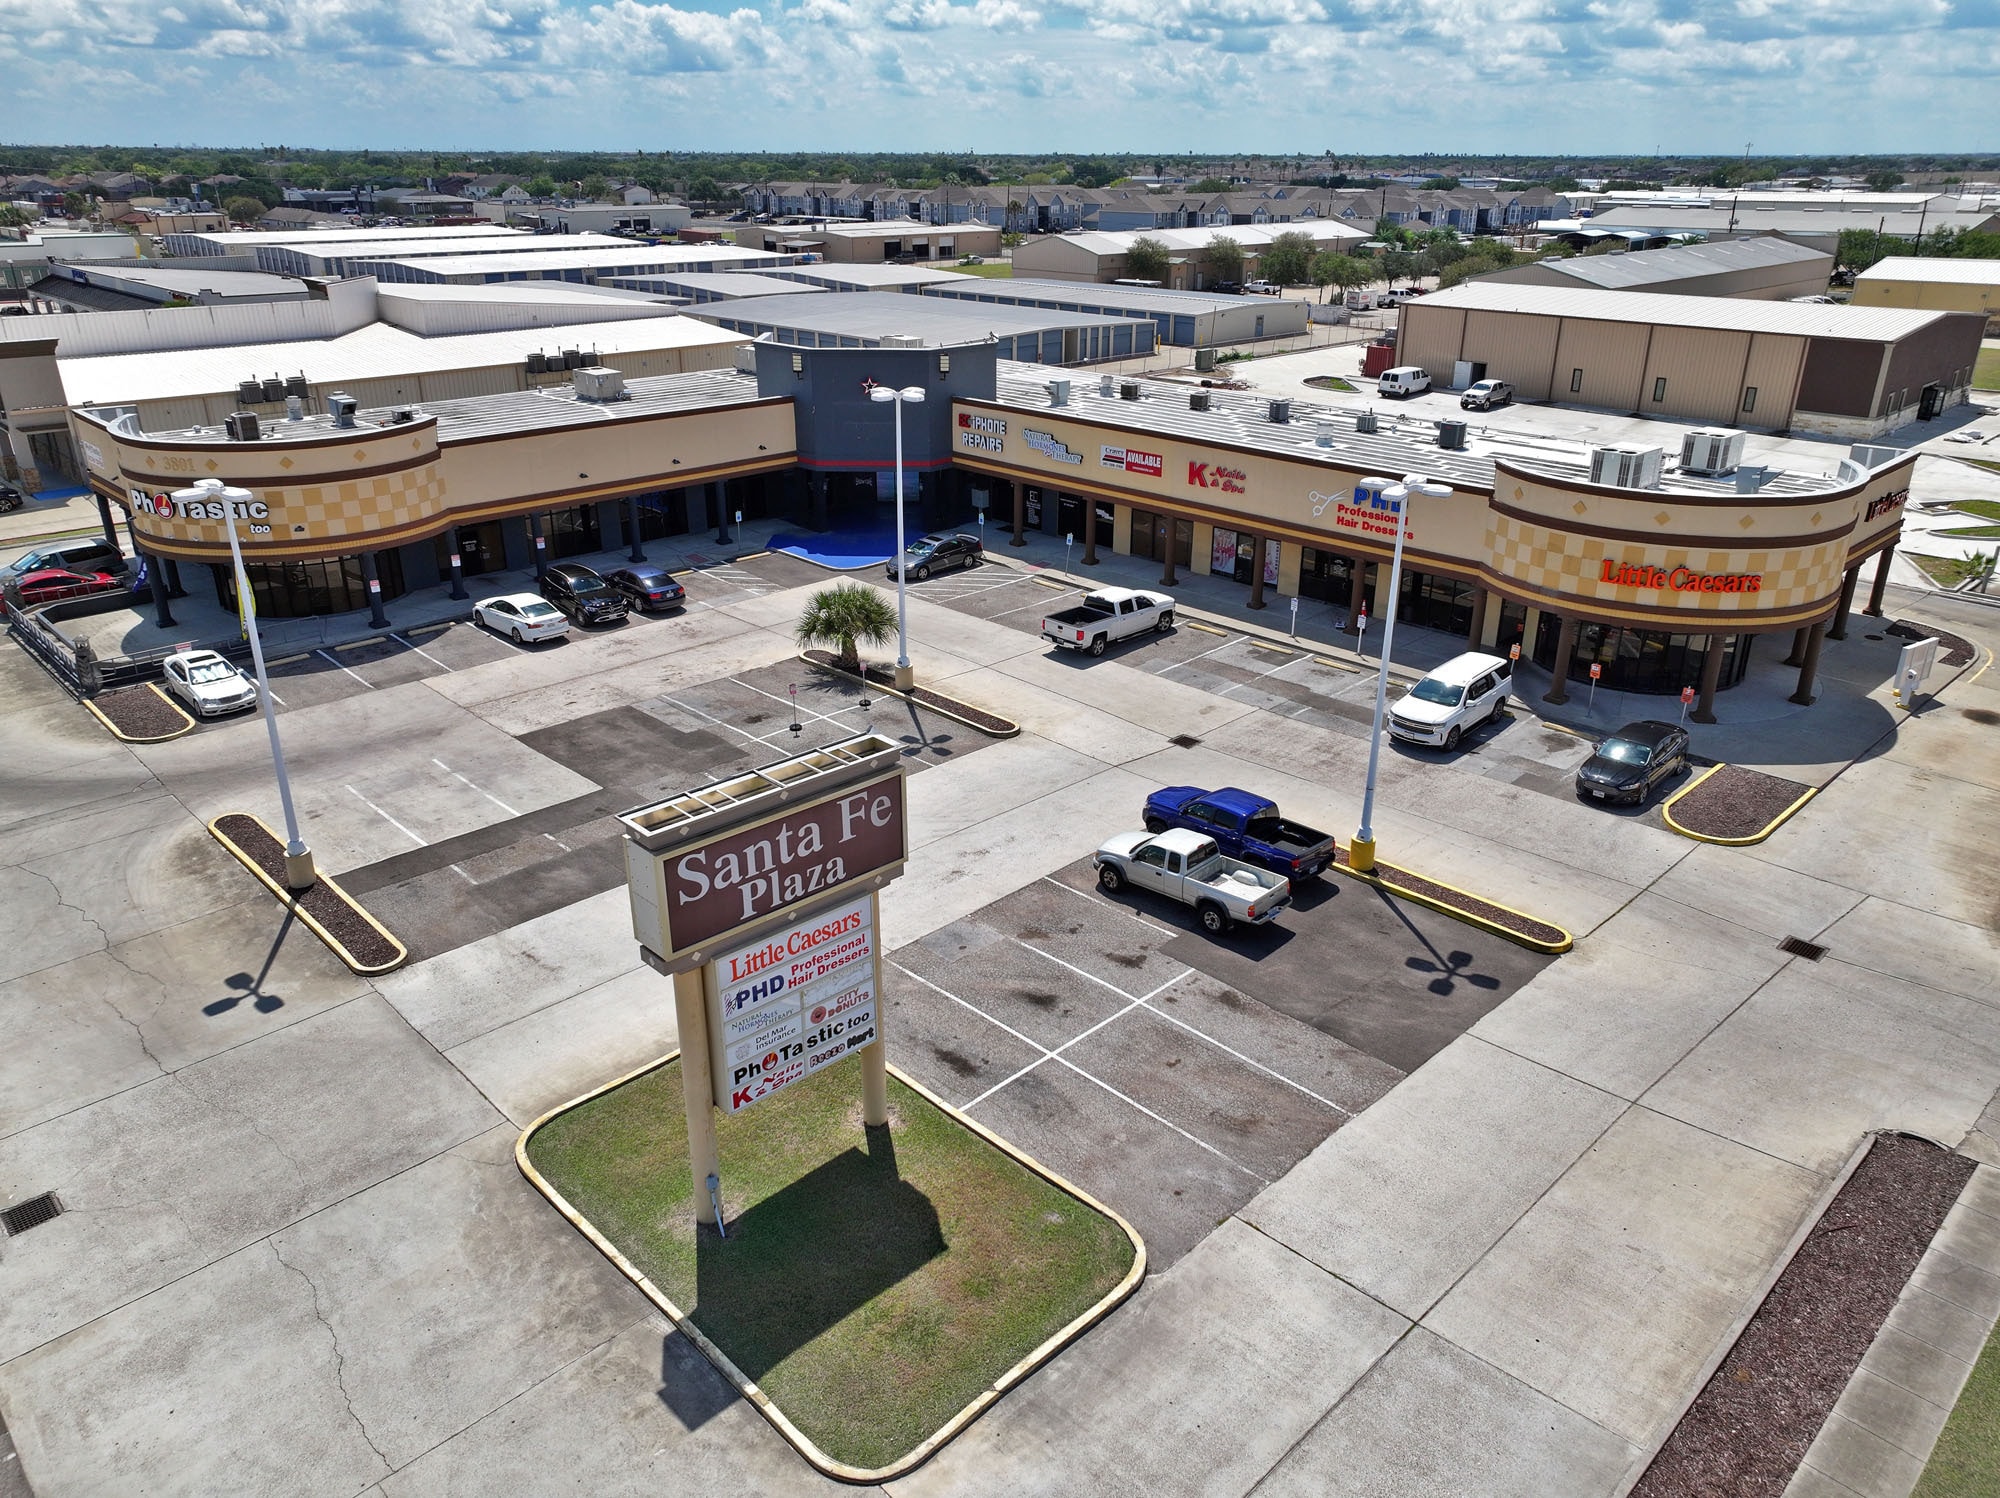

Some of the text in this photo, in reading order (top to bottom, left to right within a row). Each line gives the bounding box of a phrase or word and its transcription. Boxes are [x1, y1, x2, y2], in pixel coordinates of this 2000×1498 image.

[962, 431, 1003, 453] REPAIRS
[1028, 439, 1067, 453] HORMONES
[1051, 450, 1081, 464] THERAPY
[1127, 451, 1161, 468] AVAILABLE
[1188, 461, 1247, 488] K Nails
[1210, 479, 1246, 494] & Spa
[1336, 515, 1359, 529] Hair
[1337, 503, 1409, 526] Professionl
[249, 524, 271, 534] too
[1600, 558, 1762, 593] Little Caesars
[677, 790, 893, 906] Santa Fe
[738, 856, 847, 921] Plaza
[729, 911, 861, 983] Little Caesars
[791, 933, 866, 976] Professional
[788, 945, 870, 990] Hair Dressers
[736, 974, 785, 1010] PHD
[837, 988, 859, 1004] CITY
[828, 992, 869, 1018] DONUTS
[731, 1011, 763, 1030] NATURAL
[738, 1010, 778, 1033] HORMONES
[765, 1010, 793, 1027] THERAPY
[848, 1012, 870, 1029] too
[756, 1025, 788, 1044] Del Mar
[756, 1028, 796, 1050] Insurance
[809, 1027, 874, 1068] Reezo Mart
[732, 1061, 803, 1110] K Nails
[755, 1070, 803, 1097] & Spa
